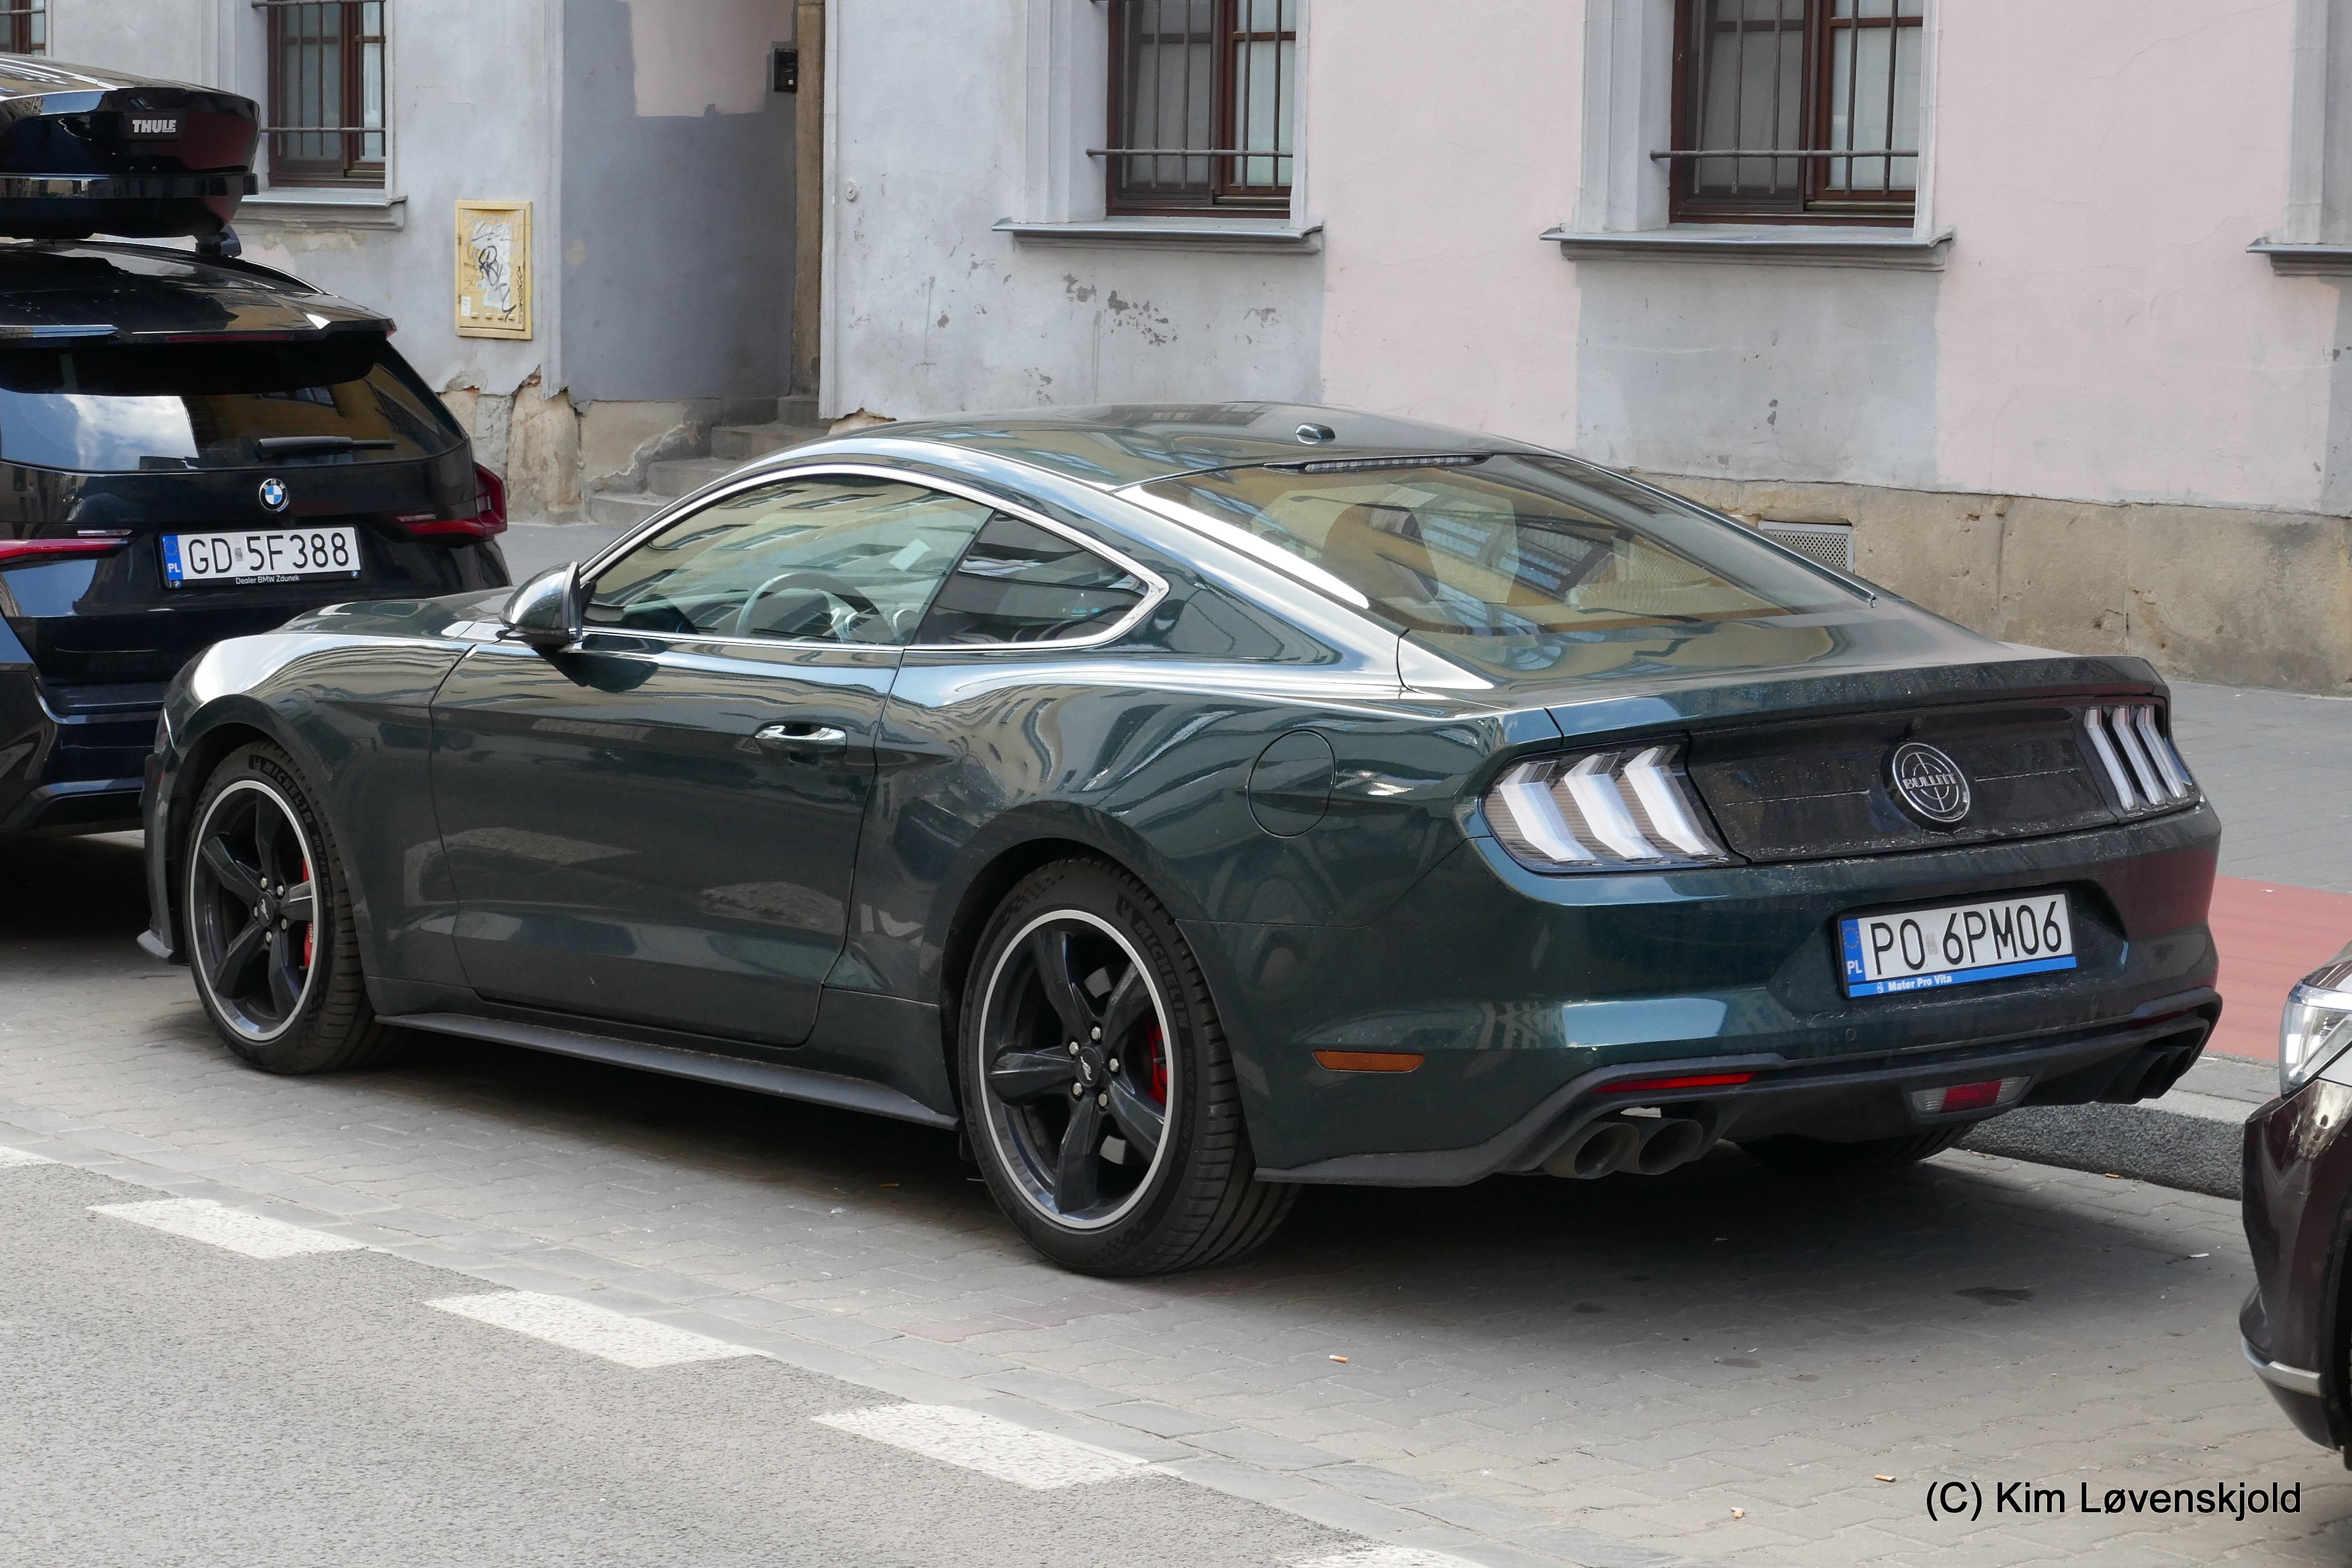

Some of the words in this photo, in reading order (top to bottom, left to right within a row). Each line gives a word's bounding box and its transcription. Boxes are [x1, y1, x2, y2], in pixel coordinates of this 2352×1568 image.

[132, 119, 177, 133] THULE
[188, 538, 233, 575] GD
[246, 532, 349, 571] 5F388
[168, 563, 181, 573] PL
[1902, 772, 1956, 790] BULLITT
[262, 761, 313, 824] MICHELIN
[1869, 918, 1926, 976] PO
[1942, 901, 2062, 965] 6PM06
[1134, 920, 1189, 1028] MICHELIN
[1847, 960, 1863, 975] PL
[1888, 980, 1915, 992] Mater
[1917, 978, 1932, 987] Pro
[1934, 974, 1953, 984] Vita
